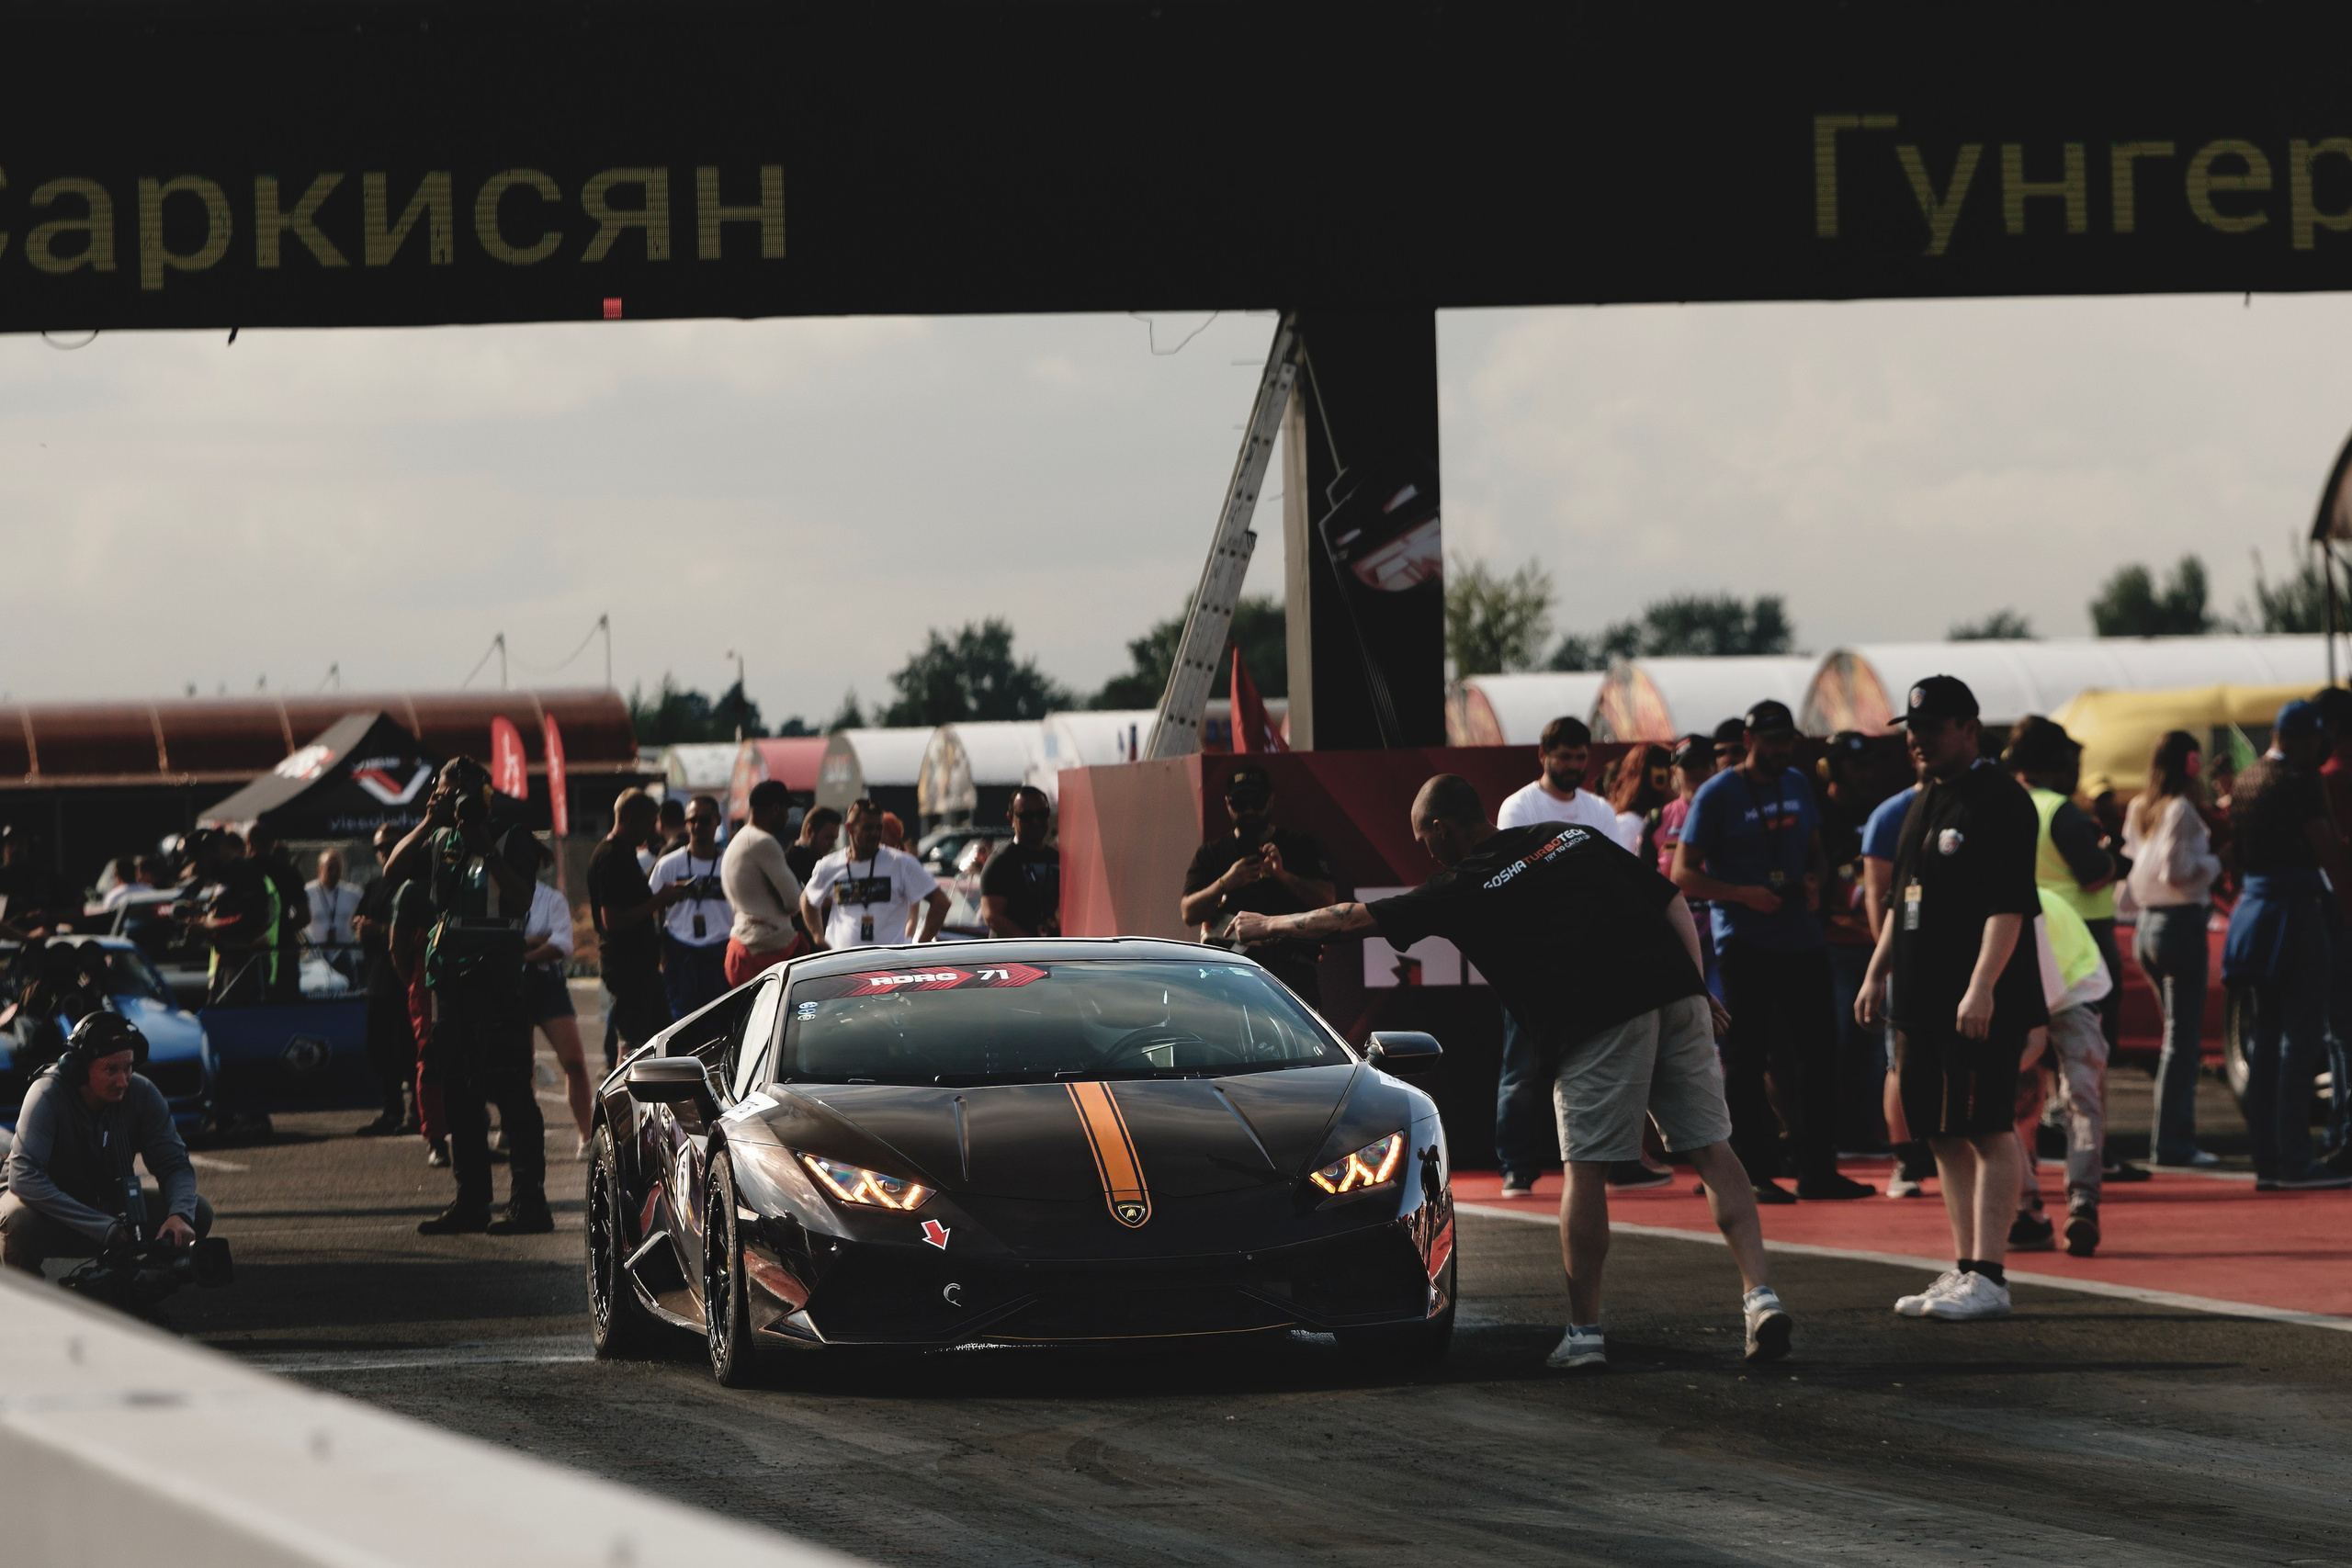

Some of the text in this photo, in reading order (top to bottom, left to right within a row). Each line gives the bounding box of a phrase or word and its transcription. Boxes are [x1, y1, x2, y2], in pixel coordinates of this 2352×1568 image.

[0, 164, 786, 290] аркисян
[1544, 852, 1556, 862] TRY
[1564, 836, 1583, 848] CATCH
[977, 969, 1010, 981] 71
